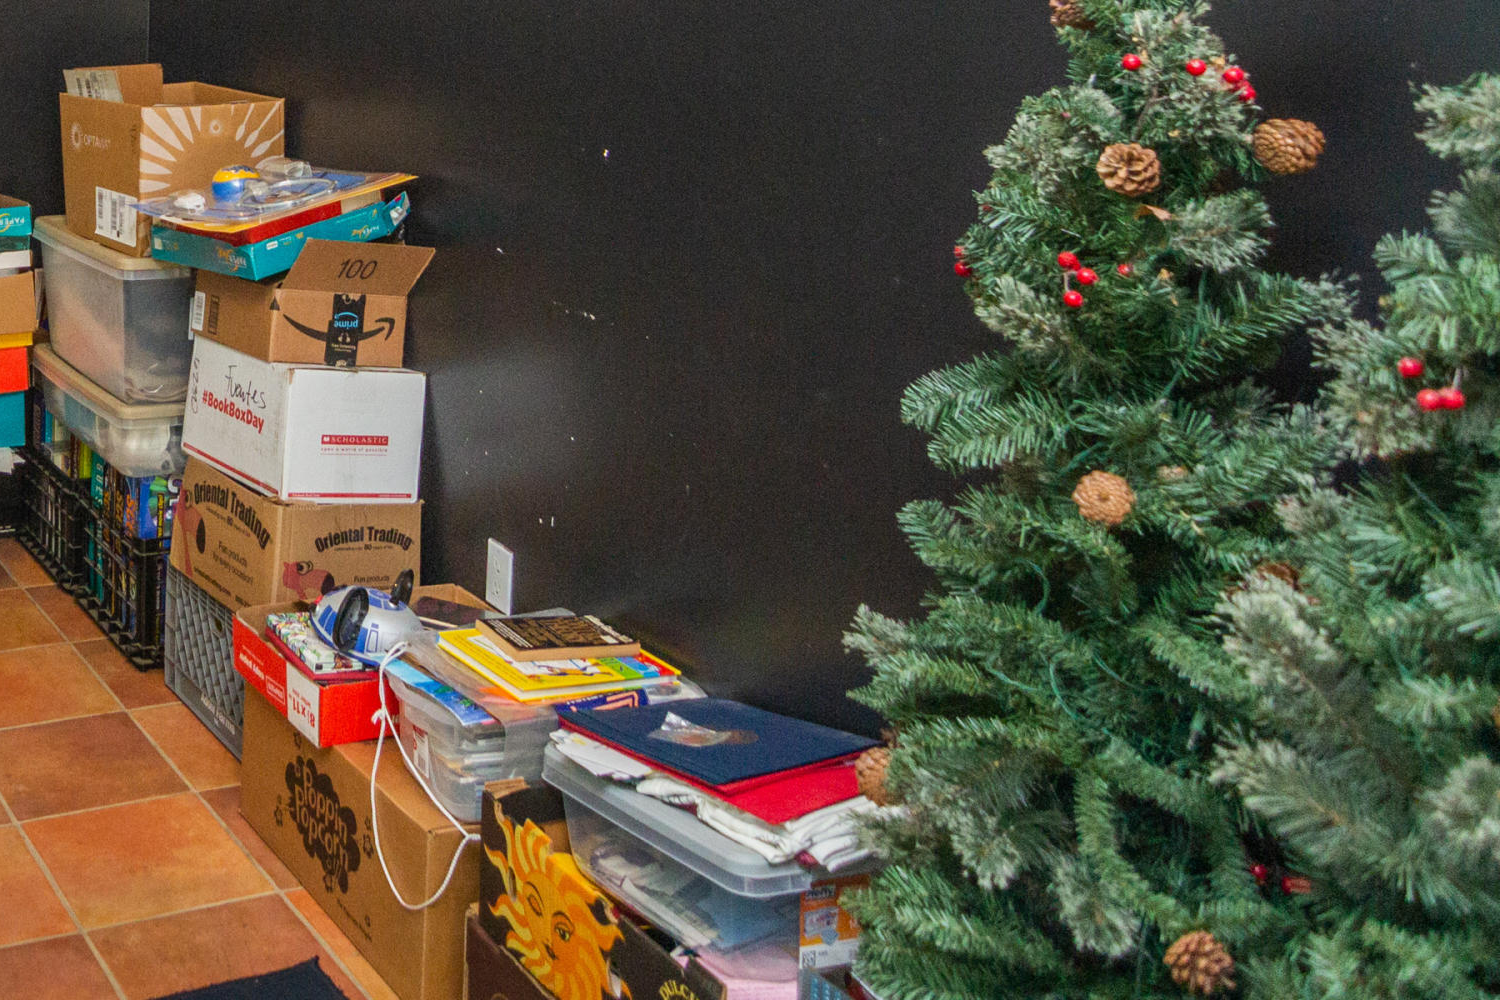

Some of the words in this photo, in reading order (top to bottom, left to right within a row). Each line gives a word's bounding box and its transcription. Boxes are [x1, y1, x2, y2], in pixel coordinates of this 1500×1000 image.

[338, 258, 378, 280] 100
[333, 319, 359, 329] prime
[202, 390, 264, 434] #BookBoxDay
[330, 436, 388, 445] SCHOLASTIC
[194, 480, 229, 510] Oriental
[231, 490, 271, 550] Trading
[314, 526, 364, 553] Oriental
[367, 526, 413, 551] Trading
[303, 765, 348, 841] Poppin
[294, 783, 349, 872] Popcorn
